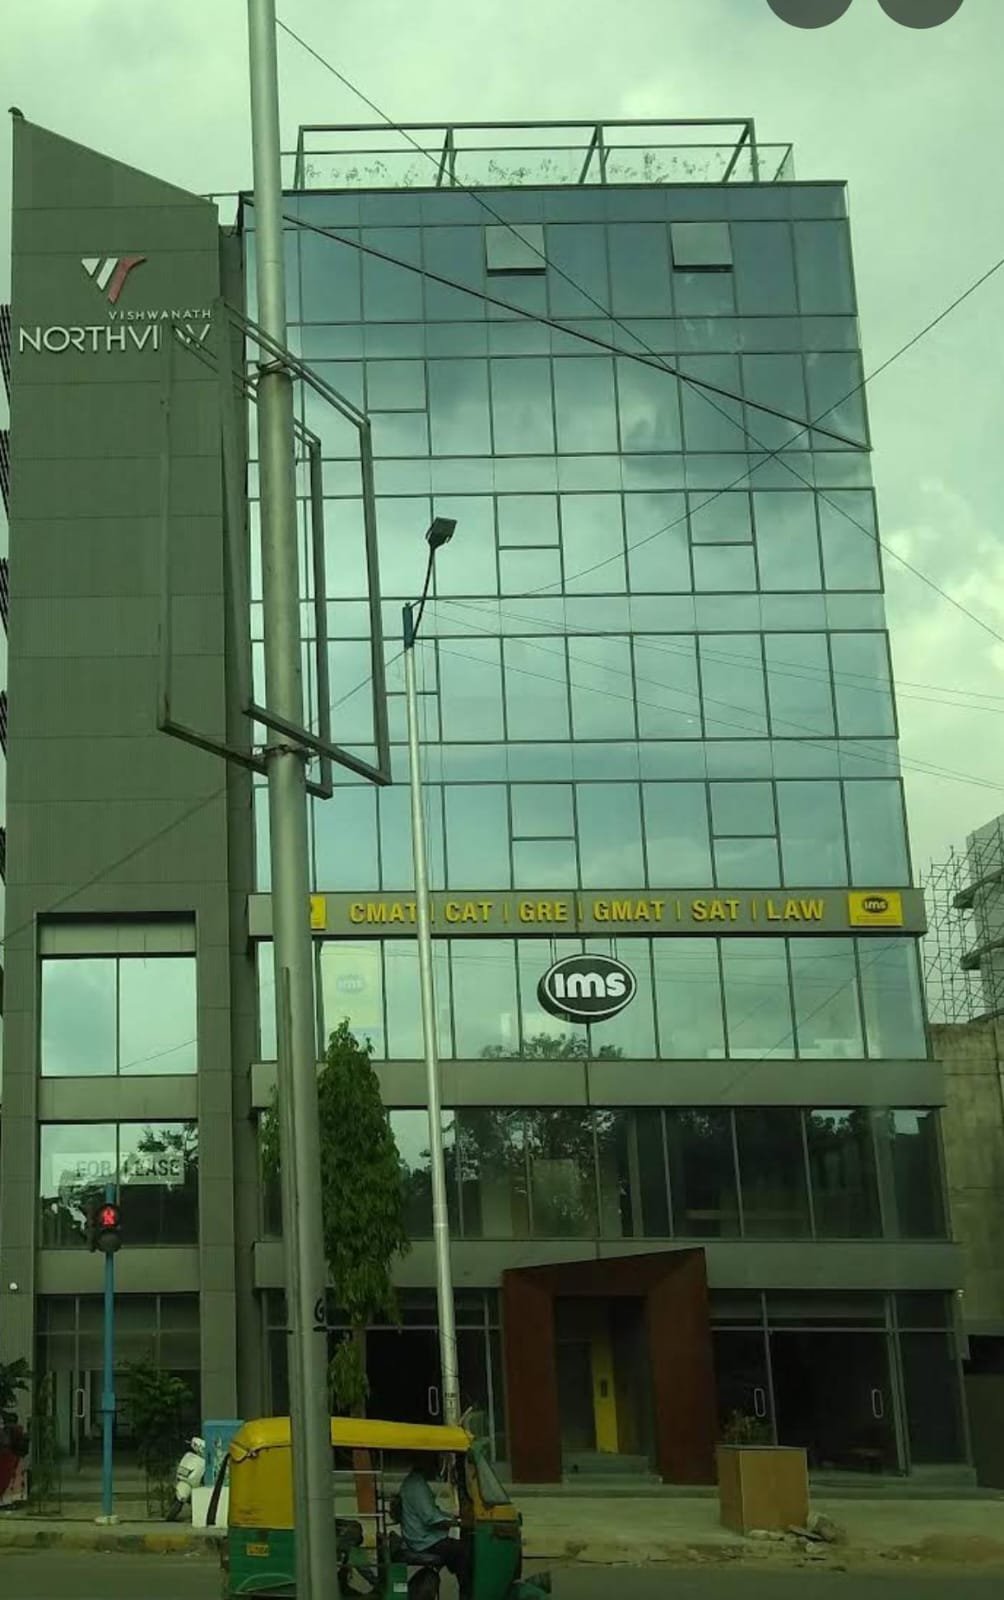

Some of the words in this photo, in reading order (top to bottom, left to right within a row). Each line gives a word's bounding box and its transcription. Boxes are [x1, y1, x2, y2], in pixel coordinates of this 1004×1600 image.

[108, 309, 212, 321] VISHWANATH
[19, 323, 211, 352] NORTHVIW
[350, 902, 417, 924] CMAT
[445, 901, 493, 923] CAT
[518, 900, 569, 923] GRE
[593, 899, 664, 922] GMAT
[692, 898, 740, 921] SAT
[767, 898, 825, 920] LAW
[77, 1160, 111, 1177] FOR
